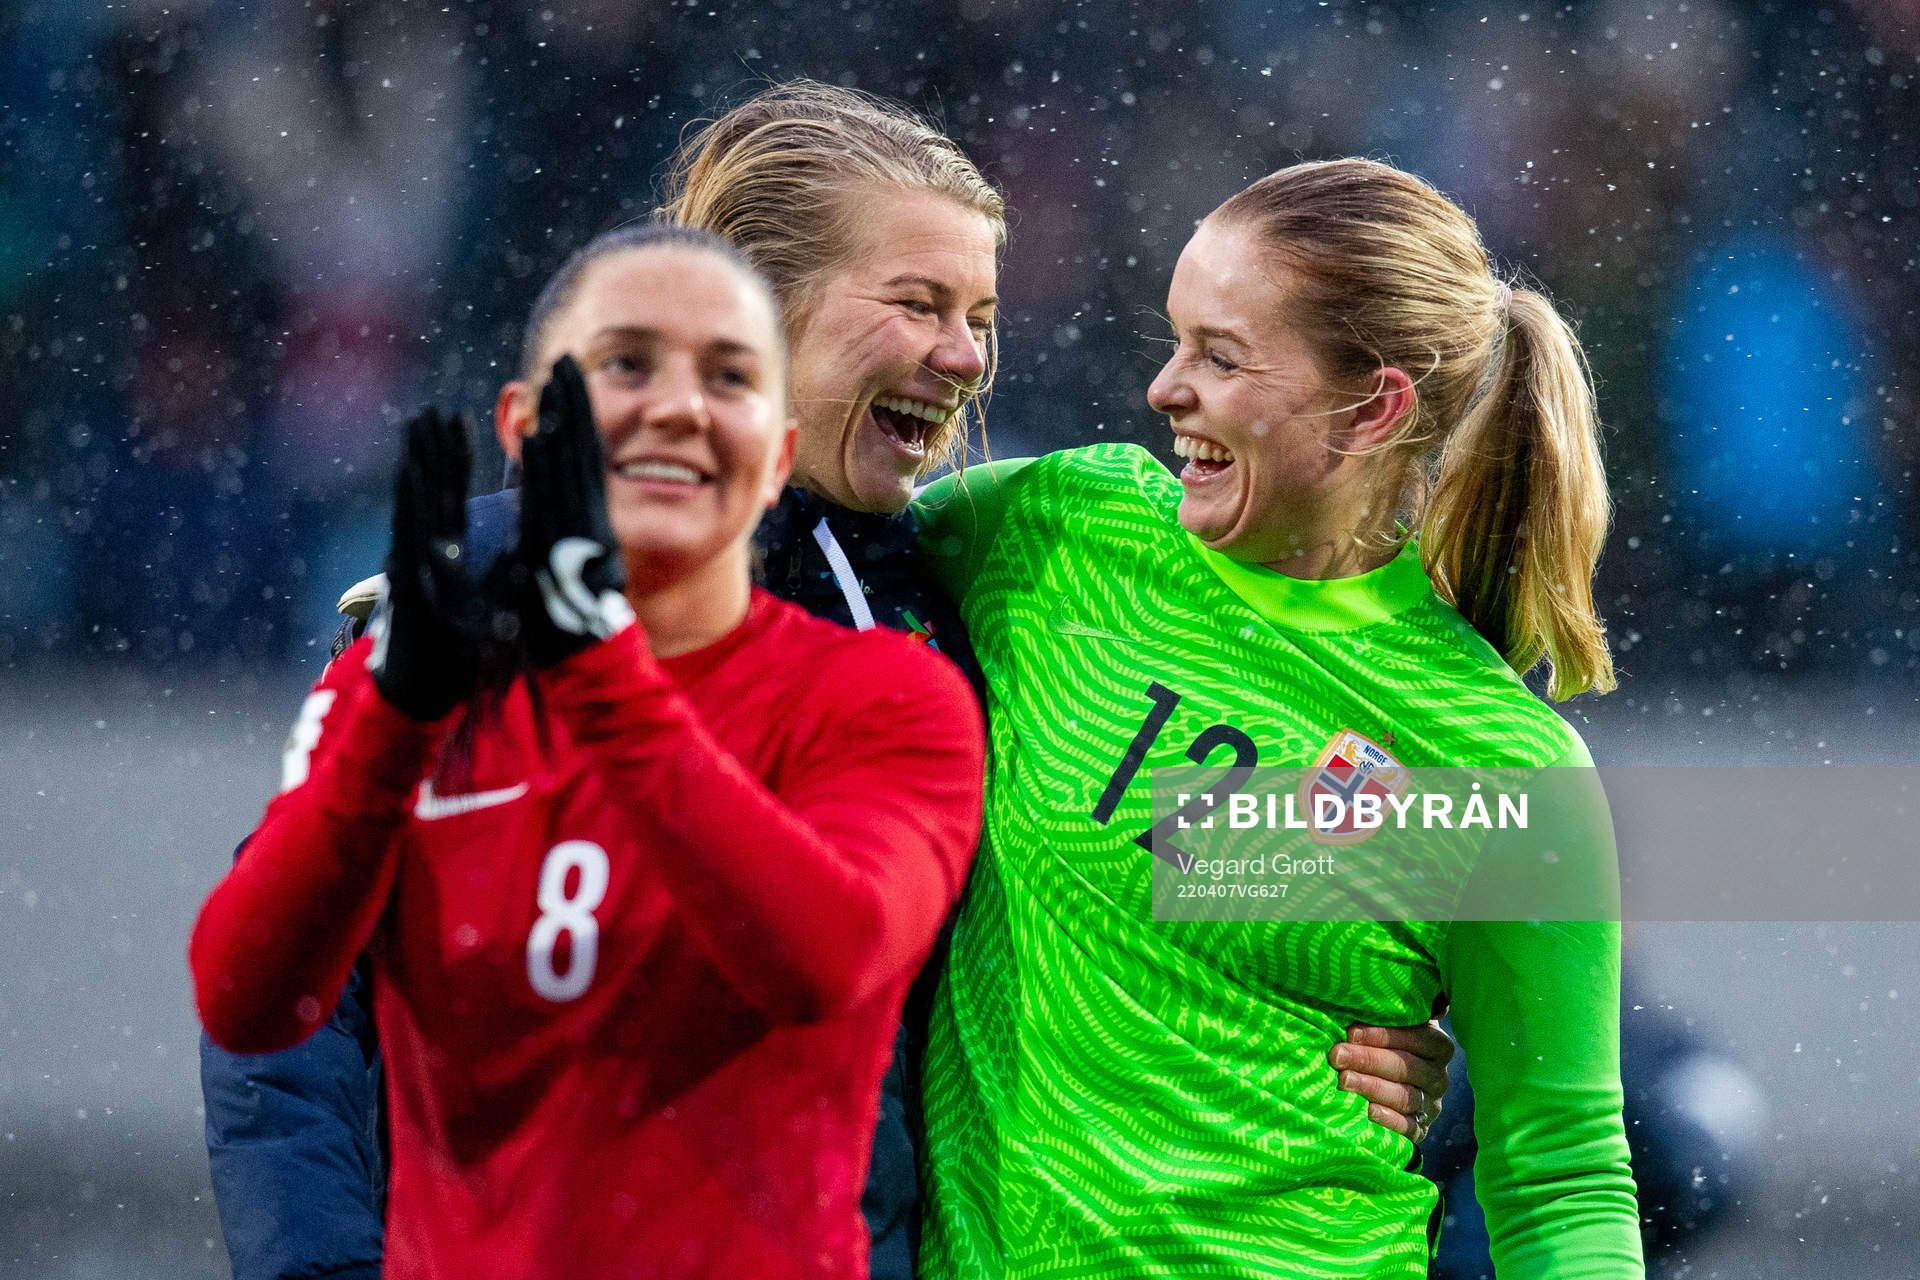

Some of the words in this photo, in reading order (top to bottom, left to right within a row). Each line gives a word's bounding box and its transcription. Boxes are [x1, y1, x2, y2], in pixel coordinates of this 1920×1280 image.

[1090, 681, 1258, 875] 12
[1363, 745, 1388, 765] NORGE
[526, 839, 610, 1002] 8
